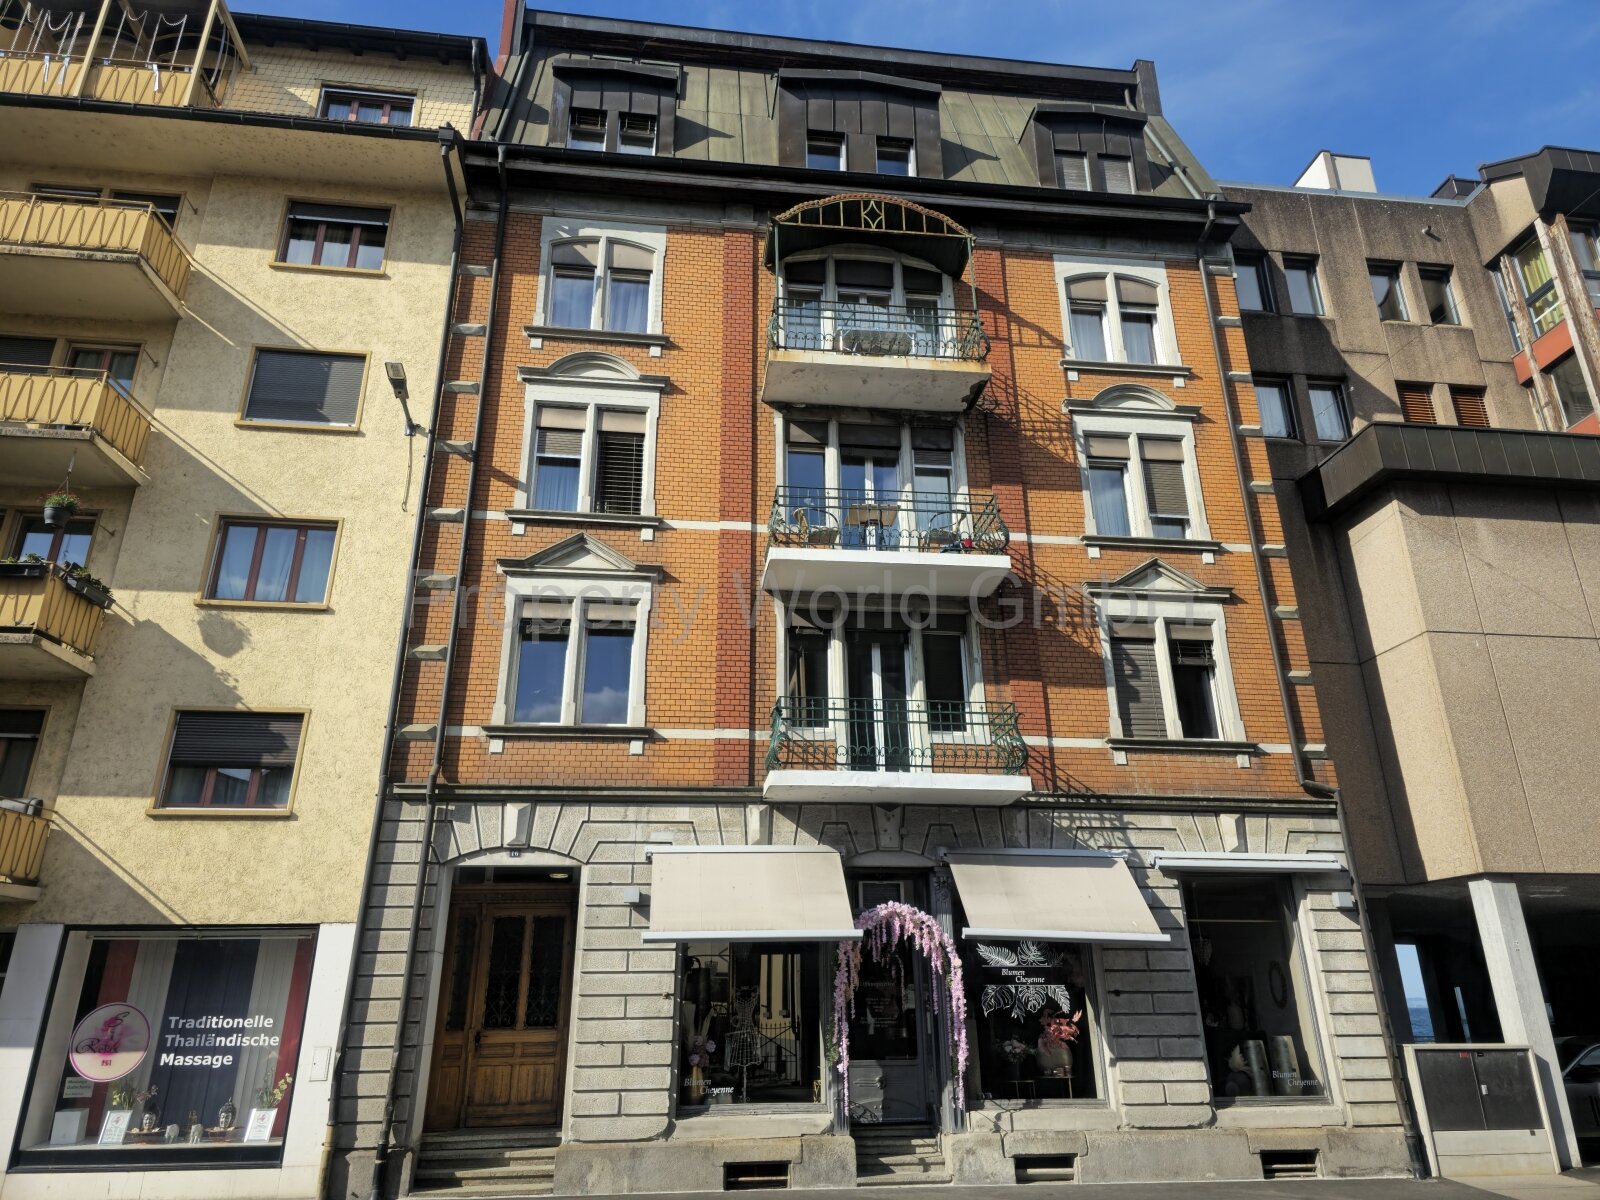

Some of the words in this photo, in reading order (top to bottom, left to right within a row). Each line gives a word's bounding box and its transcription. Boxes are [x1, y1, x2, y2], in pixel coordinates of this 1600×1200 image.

[1001, 968, 1025, 976] Blumen
[1015, 975, 1045, 985] Cheyenne
[168, 1015, 274, 1029] Traditionelle
[164, 1033, 280, 1047] Thailändische
[159, 1053, 233, 1068] Massage
[1272, 1070, 1297, 1079] Blumen
[684, 1078, 712, 1087] Blumen
[1287, 1078, 1319, 1089] Cheyenne
[700, 1085, 735, 1097] Cheyenne
